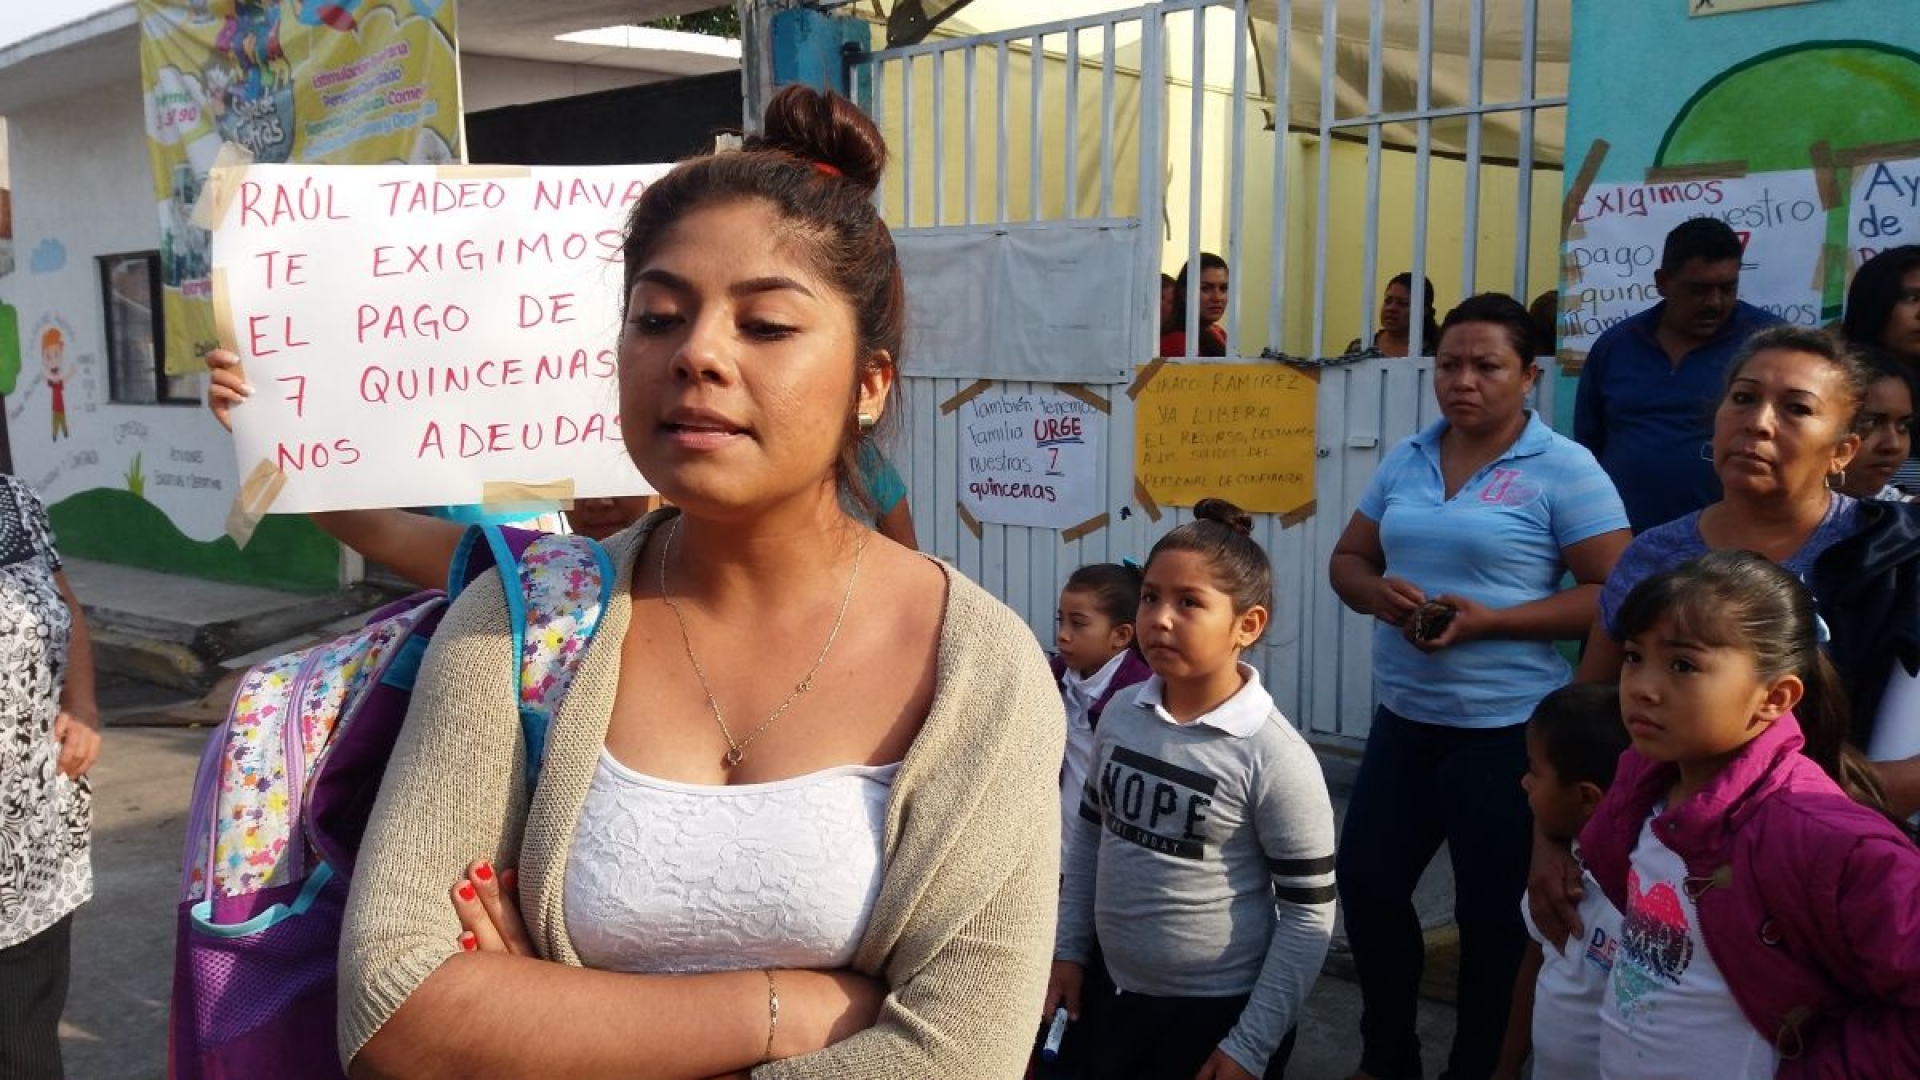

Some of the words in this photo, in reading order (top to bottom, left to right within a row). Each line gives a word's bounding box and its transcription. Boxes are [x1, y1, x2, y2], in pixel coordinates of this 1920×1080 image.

[240, 176, 350, 228] RAÚL
[378, 180, 505, 217] TADEO
[533, 177, 645, 211] NAVA
[1688, 186, 1815, 228] estro
[1859, 203, 1902, 239] de
[255, 250, 308, 290] TE
[372, 229, 625, 278] EXIGIMOS
[1572, 244, 1654, 284] pago
[1580, 282, 1660, 316] quinc
[248, 314, 310, 357] EL
[357, 303, 470, 344] PAGO
[518, 292, 576, 329] DE
[275, 374, 307, 418] 7
[359, 348, 617, 404] QUINCENAS
[277, 438, 361, 474] NOS
[417, 412, 624, 460] ADEUDAS
[1034, 415, 1083, 441] URGE
[1144, 431, 1167, 450] EL
[969, 448, 1033, 473] nuestras
[1047, 447, 1059, 470] 7
[969, 476, 1057, 502] quincenas
[1099, 762, 1211, 840] NOPE
